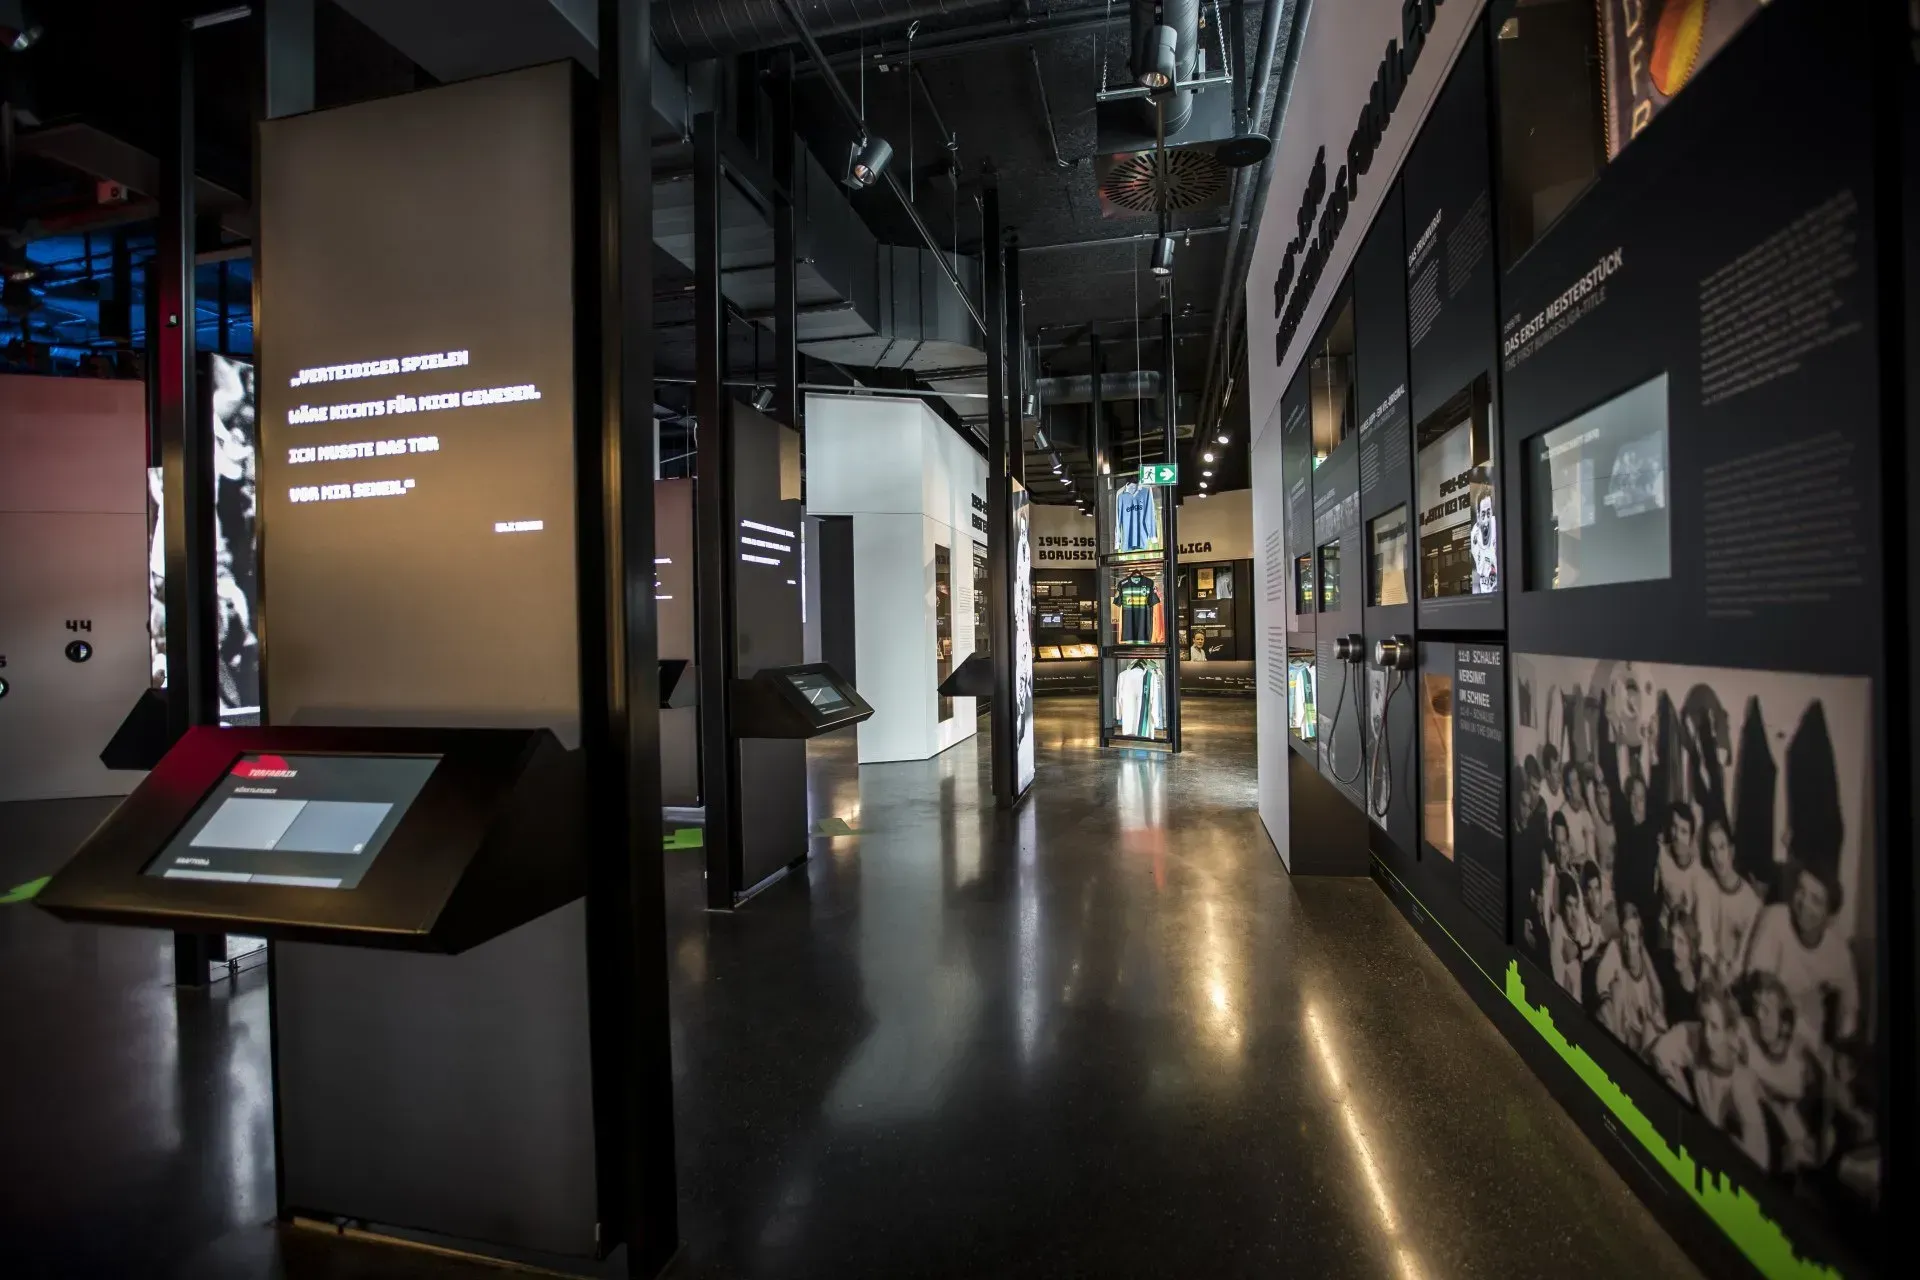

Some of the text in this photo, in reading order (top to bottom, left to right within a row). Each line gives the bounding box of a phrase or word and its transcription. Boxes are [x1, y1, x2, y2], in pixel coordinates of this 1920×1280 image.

[1504, 246, 1624, 357] DAS ERSTE MEISTERSTÜCK
[401, 350, 469, 372] SPIELEN
[329, 400, 385, 420] NICHTS
[387, 395, 417, 416] FÜR
[418, 392, 460, 412] MICH
[289, 436, 440, 464] ICH MUSSTE DAS TOR
[289, 485, 319, 503] VOR
[321, 484, 351, 500] MIR
[1038, 536, 1096, 547] 1945-196
[1038, 542, 1212, 561] BORUSSI LIGA
[66, 620, 92, 632] 44
[1472, 650, 1501, 665] SCHALKE
[1459, 669, 1487, 685] VERSINKT
[1467, 690, 1491, 708] SCHNEE
[248, 769, 298, 778] TORFABRIK
